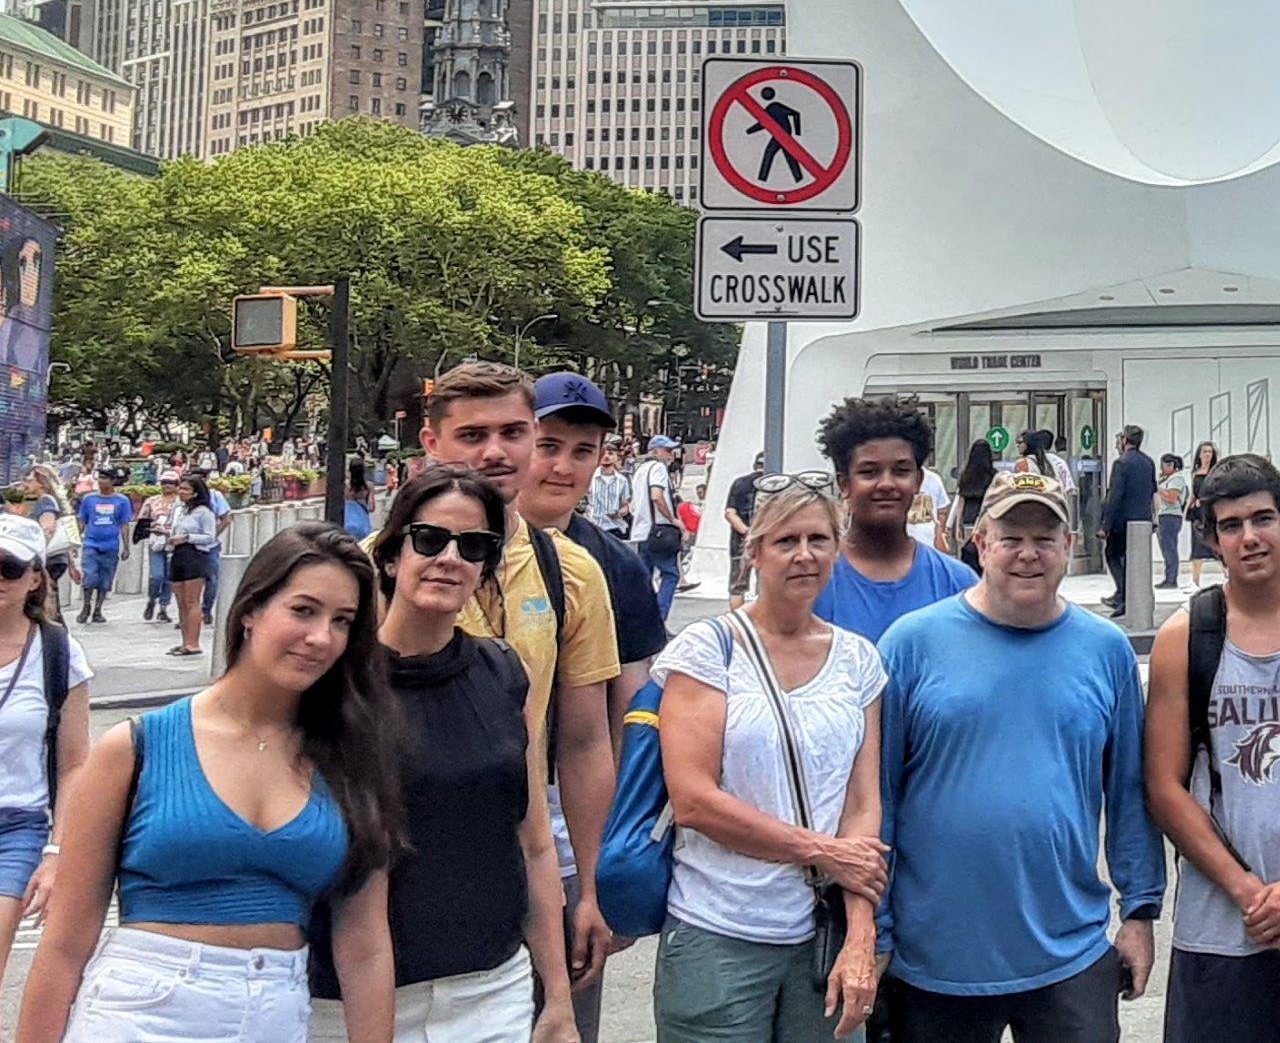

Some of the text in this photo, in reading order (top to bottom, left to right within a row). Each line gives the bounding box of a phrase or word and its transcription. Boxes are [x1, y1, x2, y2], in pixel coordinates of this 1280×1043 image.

[787, 235, 840, 263] USE
[710, 274, 846, 303] CROSSWALK
[1217, 684, 1273, 695] SOUTHERN
